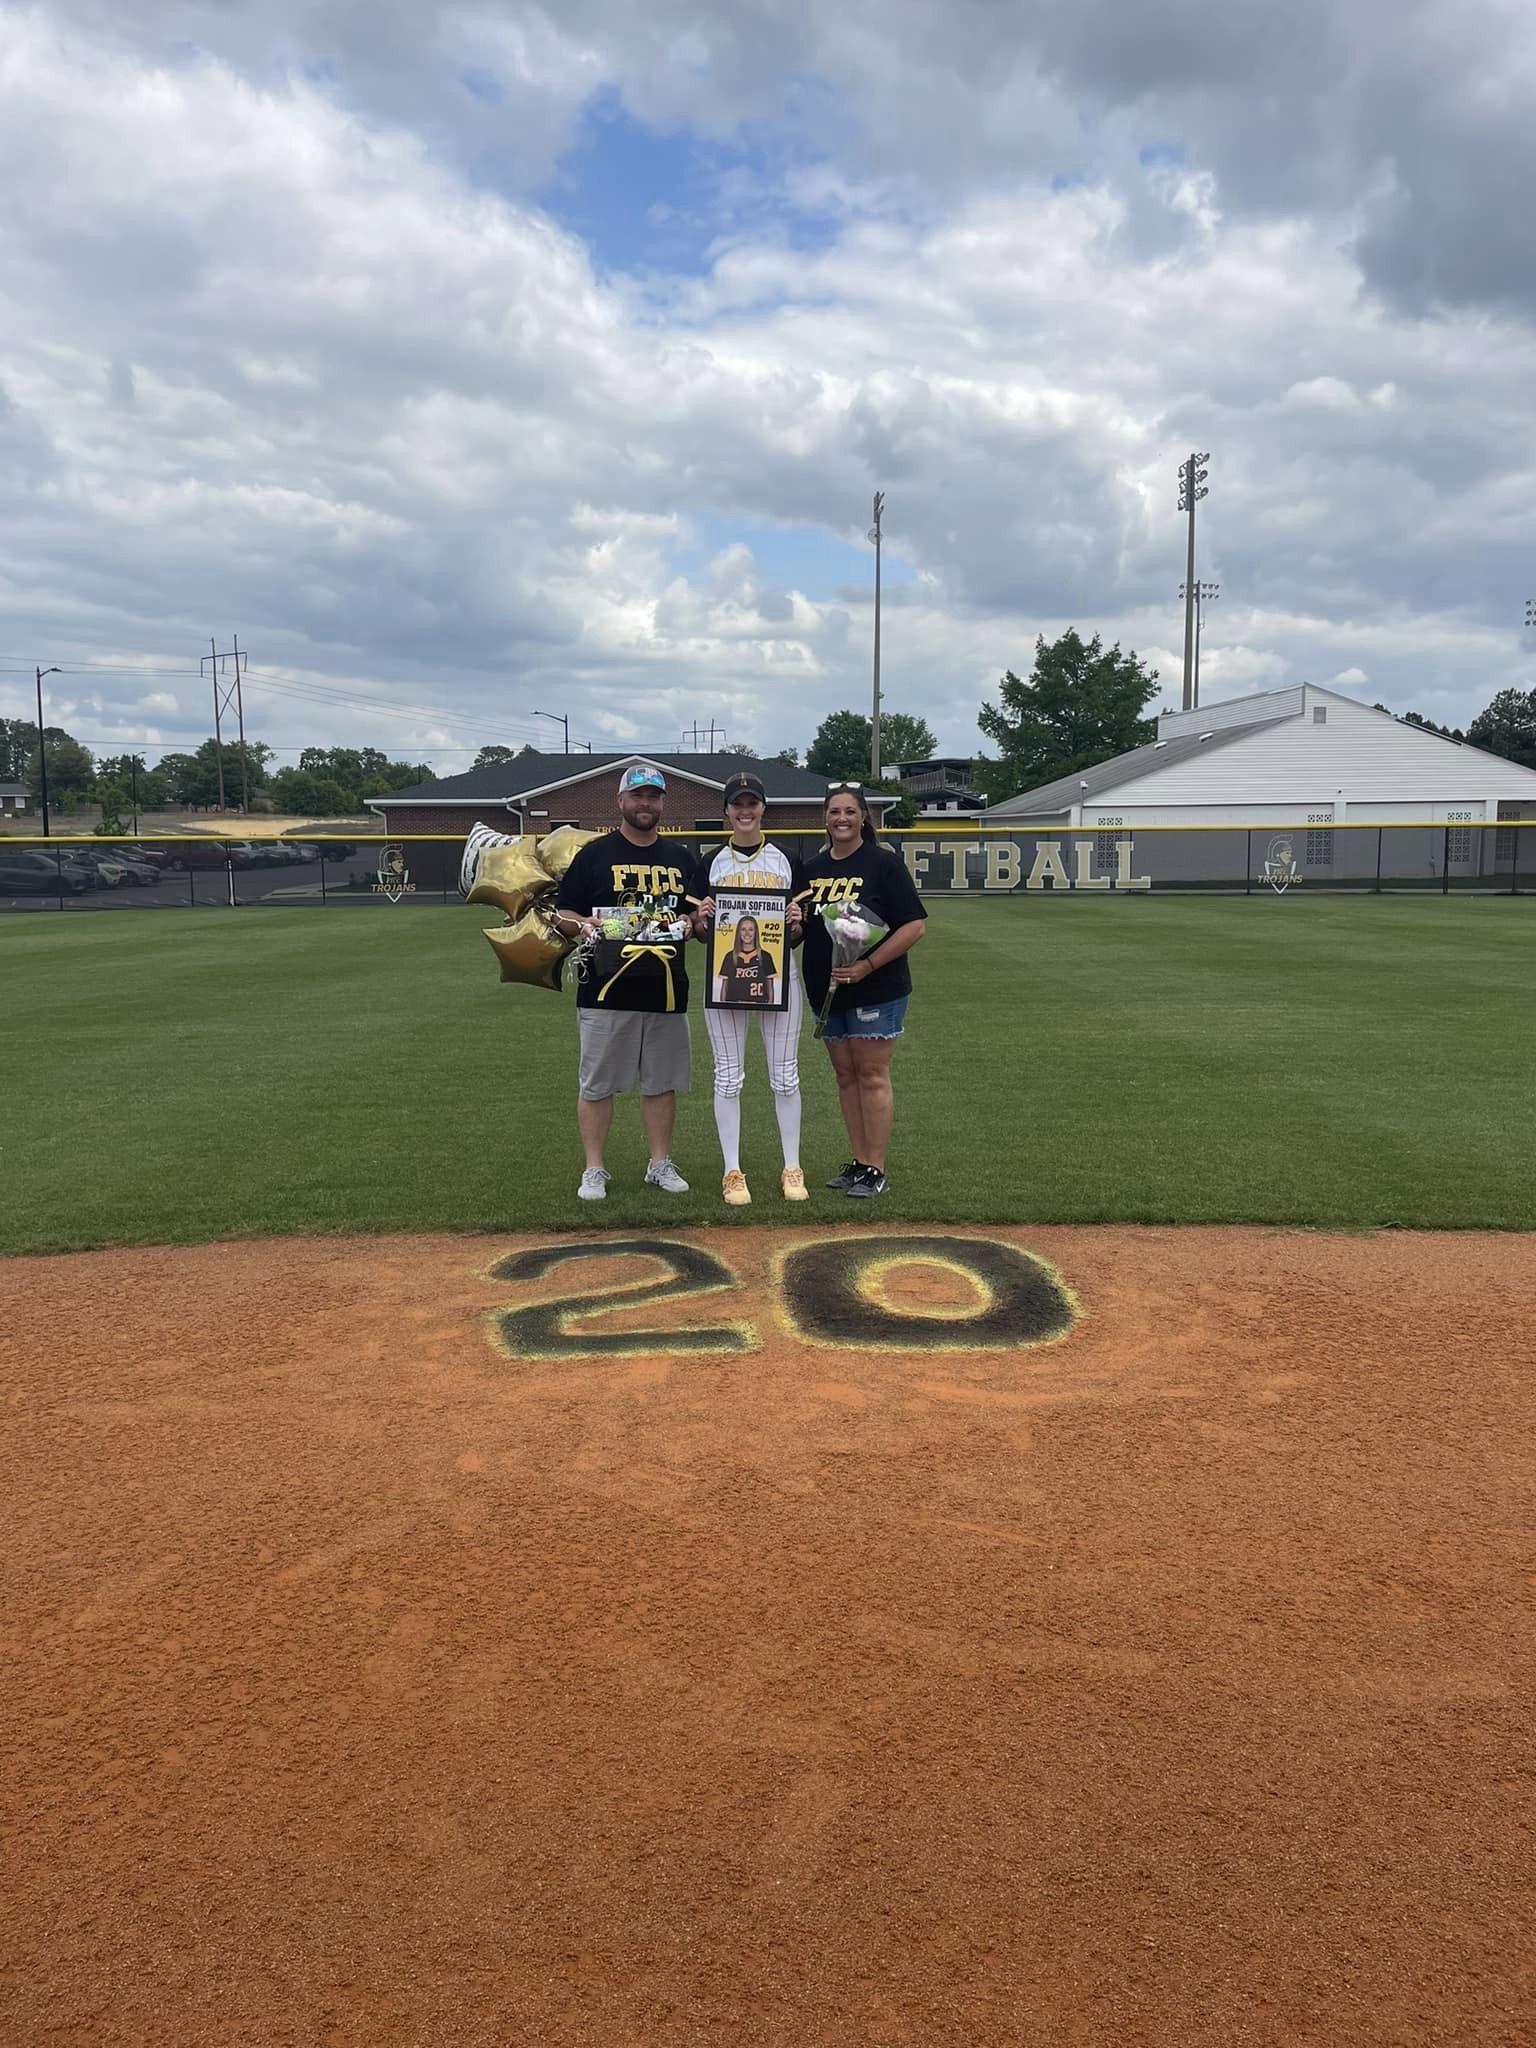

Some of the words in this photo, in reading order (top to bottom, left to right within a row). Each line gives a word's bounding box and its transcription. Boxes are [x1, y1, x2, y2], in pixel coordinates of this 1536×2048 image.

[878, 841, 1151, 888] FTBALL
[370, 883, 416, 892] TROJANS
[611, 864, 684, 894] FTCC
[1257, 874, 1303, 884] TROJANS
[718, 900, 747, 910] TROJAN
[749, 901, 785, 912] SOFTBALL
[482, 1233, 1086, 1361] 20
